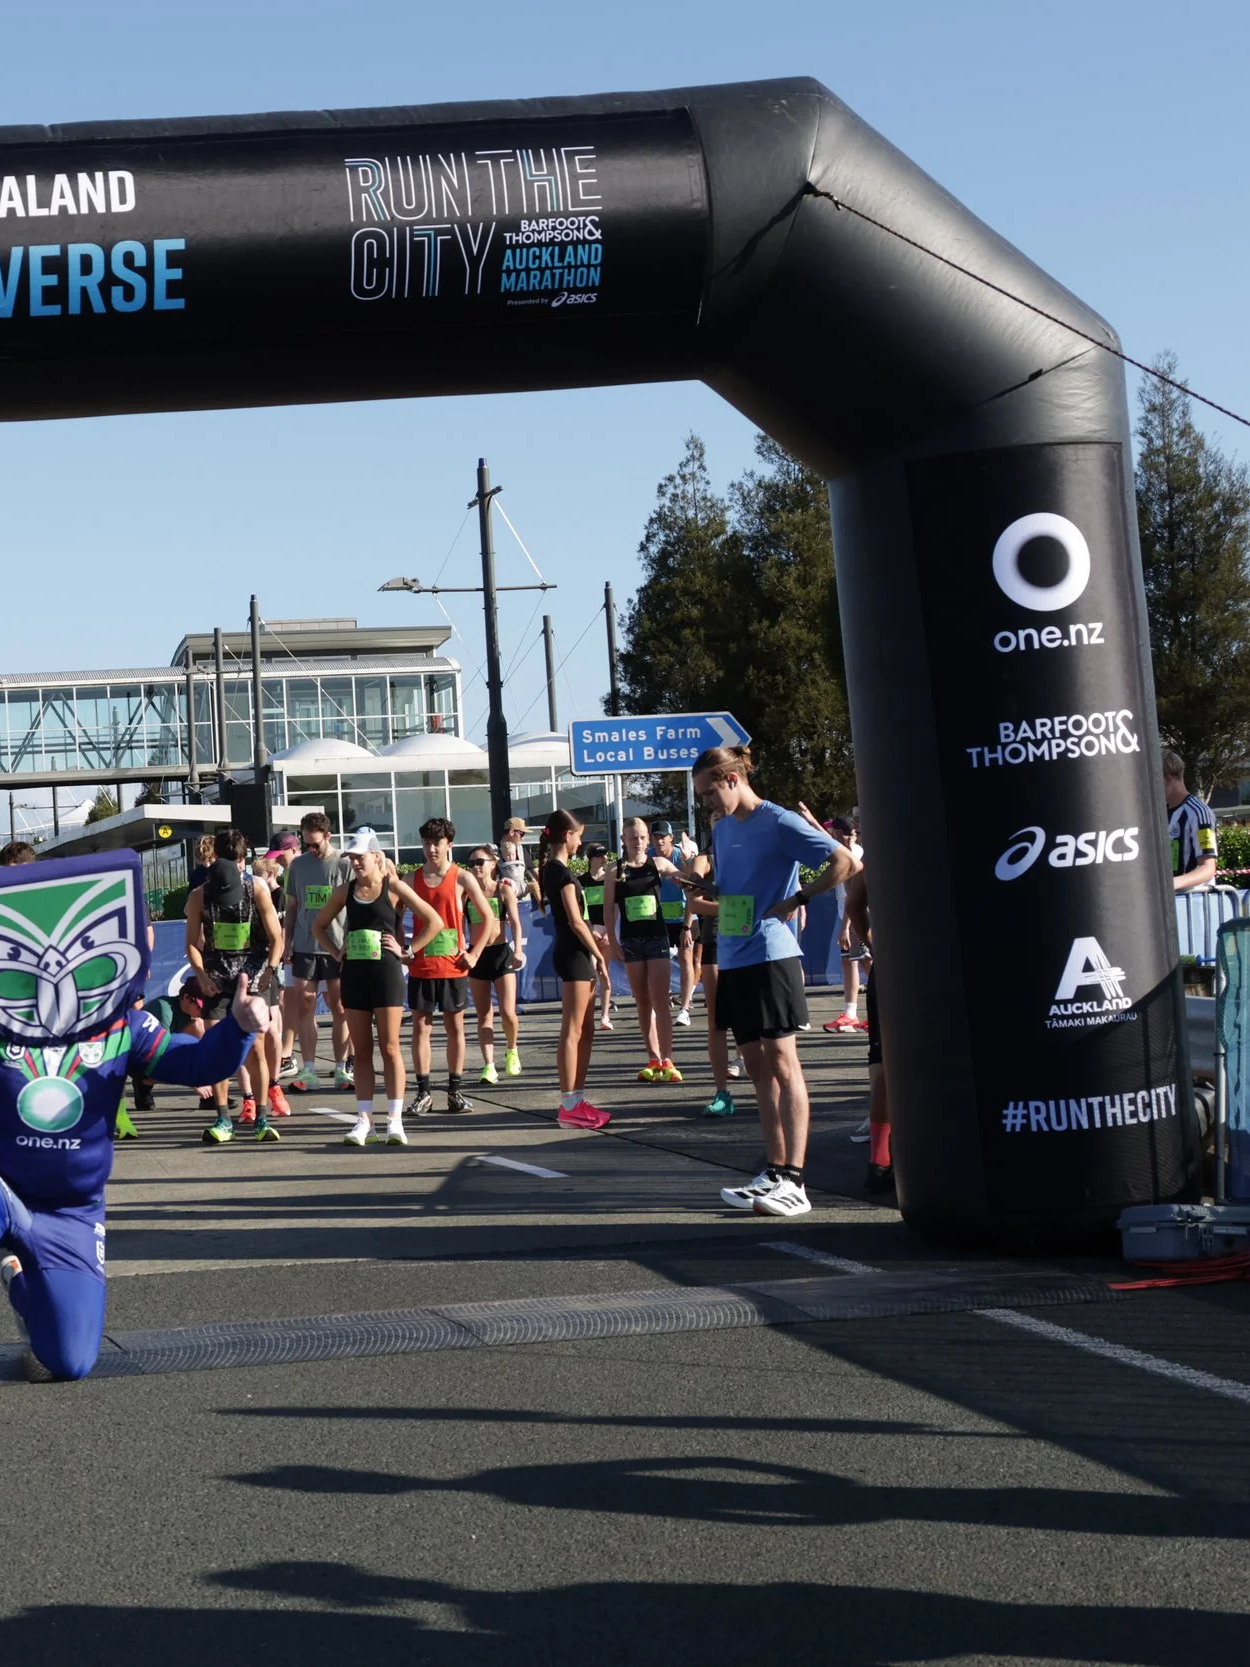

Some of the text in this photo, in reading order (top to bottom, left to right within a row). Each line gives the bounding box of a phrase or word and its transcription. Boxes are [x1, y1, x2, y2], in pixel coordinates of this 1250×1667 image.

[343, 145, 602, 222] RUN THE
[503, 229, 584, 245] THOMPSON
[350, 222, 496, 300] CITY
[502, 243, 603, 271] AUCKLAND
[500, 266, 601, 293] MARATHON
[993, 622, 1105, 653] one.nz
[582, 726, 701, 744] Smales Farm
[583, 746, 699, 763] Local Buses
[966, 735, 1117, 768] THOMPSON
[308, 892, 327, 903] TIM
[1049, 997, 1132, 1016] AUCKLAND
[1086, 1011, 1138, 1026] MAKAURAU
[1002, 1083, 1177, 1133] #RUNTHECITY
[16, 1135, 82, 1150] one.nz
